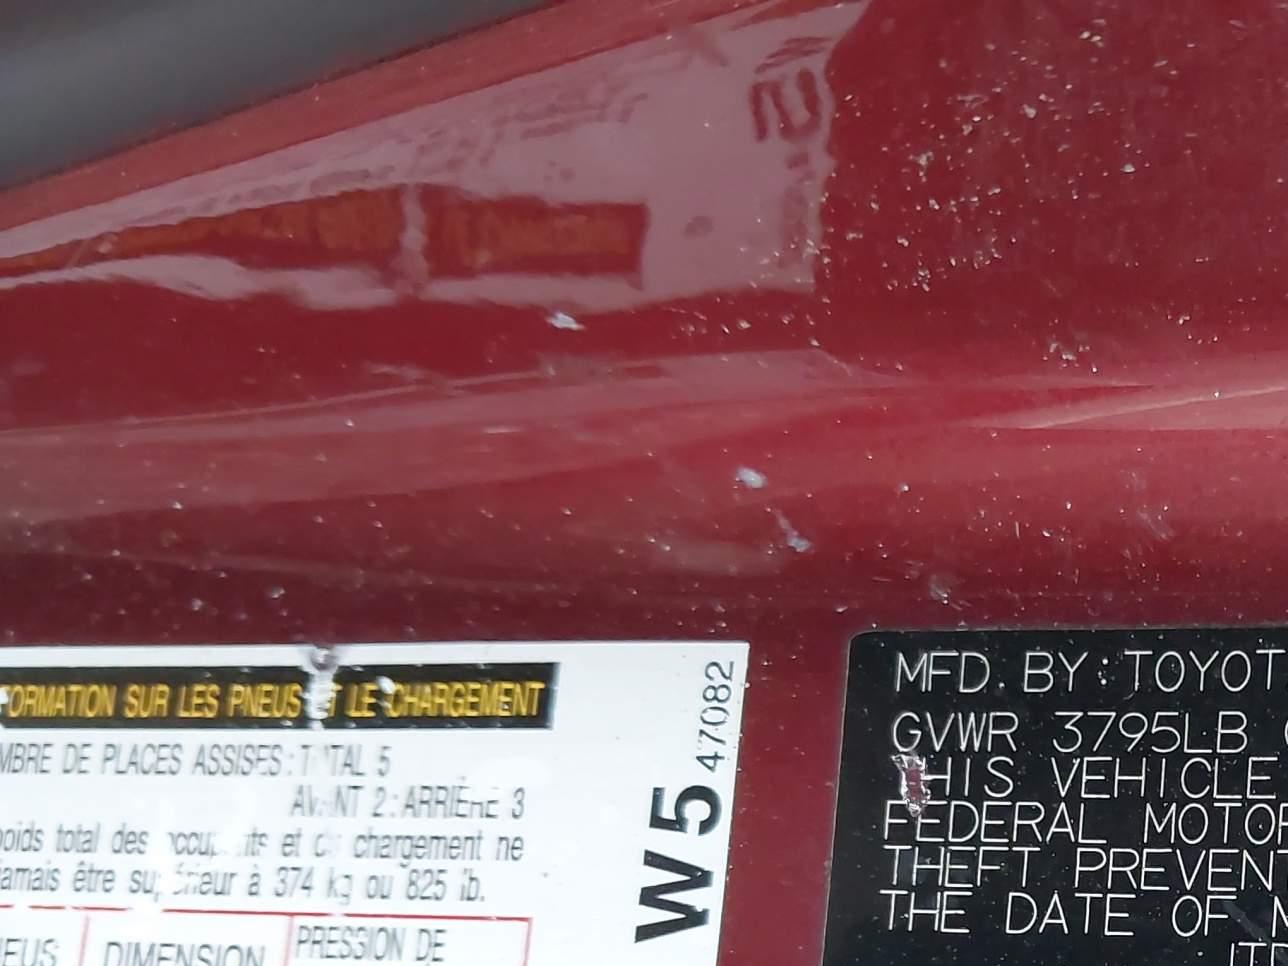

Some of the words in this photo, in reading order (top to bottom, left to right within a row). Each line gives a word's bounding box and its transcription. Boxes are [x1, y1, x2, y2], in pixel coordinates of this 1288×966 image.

[895, 651, 1005, 693] MFD.
[123, 683, 170, 718] SUR
[176, 683, 221, 718] LES
[228, 683, 303, 718] PNEUS
[343, 682, 379, 718] LE
[384, 681, 545, 718] CHARGEMENT
[695, 661, 735, 772] 47082
[893, 711, 1018, 752] GVWR
[1052, 711, 1248, 754] 3795LB
[63, 743, 92, 775] DE
[101, 743, 183, 776] PLACES
[301, 743, 367, 777] TTAL
[377, 745, 394, 777] 5
[891, 755, 1014, 797] HIS
[1053, 756, 1278, 801] VEHICLE
[511, 786, 526, 819] 3
[883, 800, 1107, 845] FEDERAL
[0, 819, 45, 852] oids
[56, 821, 101, 853] total
[112, 822, 149, 854] des
[281, 827, 302, 857] et
[353, 826, 483, 868] chargement
[495, 835, 524, 861] ne
[0, 859, 61, 891] amais
[72, 860, 117, 893] être
[247, 863, 262, 896] à
[273, 866, 313, 898] 374
[366, 874, 395, 900] ou
[405, 868, 448, 901] 825
[882, 845, 1040, 890] THEFT
[878, 888, 974, 936] THE
[1004, 890, 1136, 938] DATE
[1172, 892, 1239, 940] OF
[295, 925, 407, 962] PRESSION
[415, 928, 448, 963] DE
